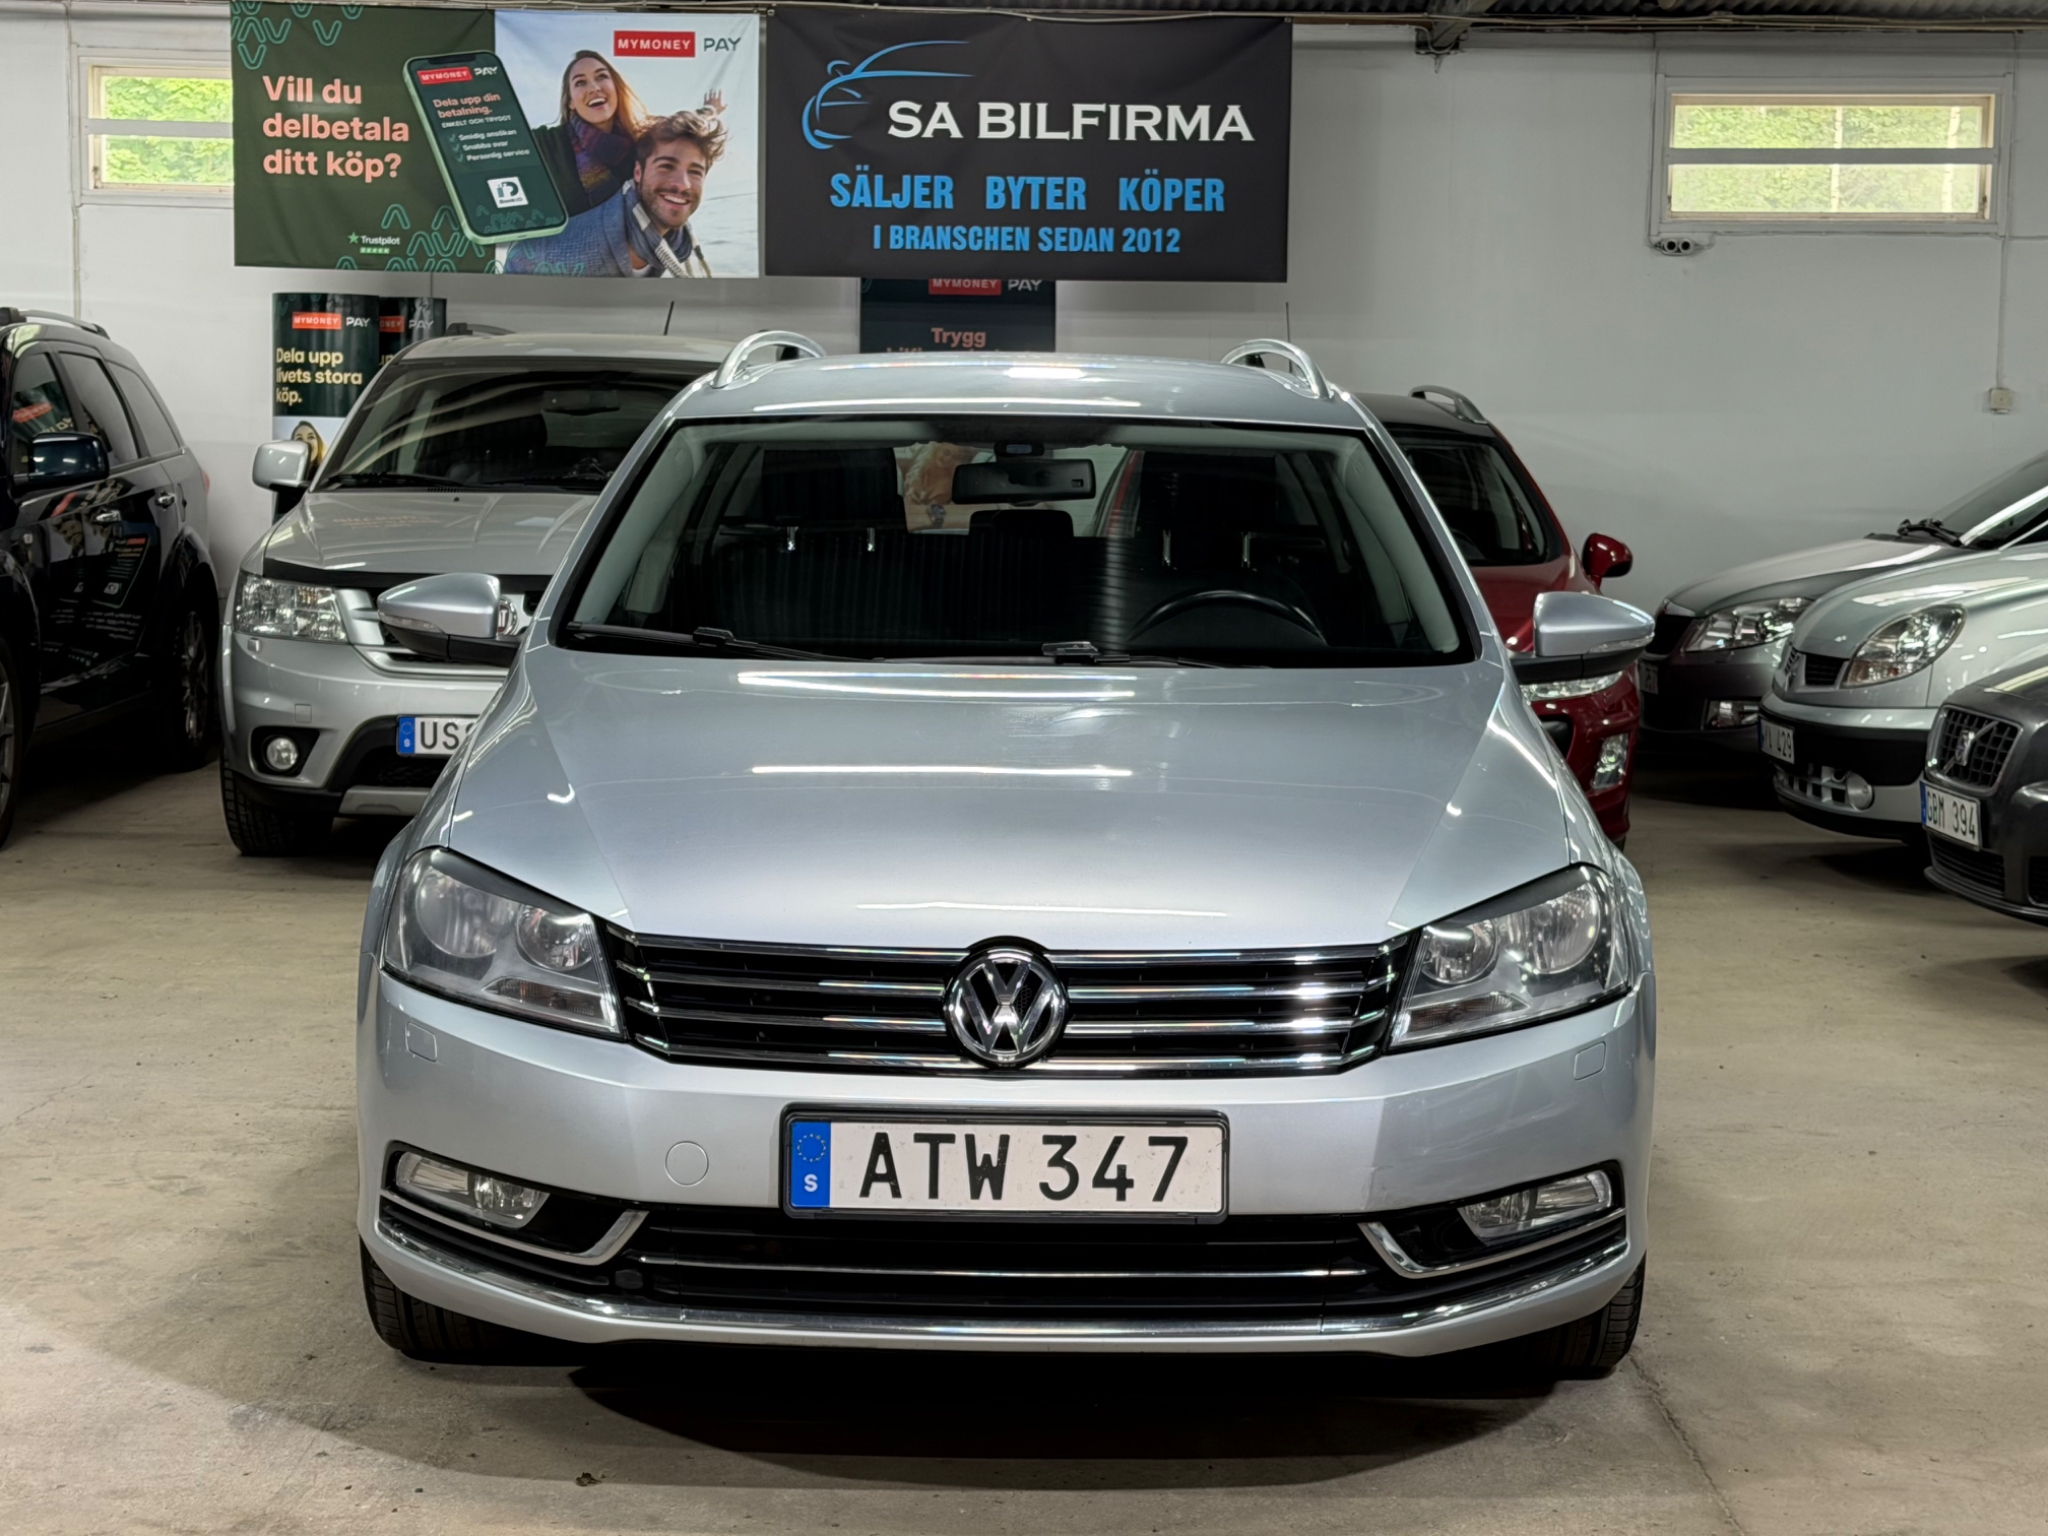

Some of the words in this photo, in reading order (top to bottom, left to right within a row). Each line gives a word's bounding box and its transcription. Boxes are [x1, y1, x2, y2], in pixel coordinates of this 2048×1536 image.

[617, 38, 691, 51] MYMONEY
[703, 37, 742, 52] PAY
[420, 70, 468, 81] MYMONEY
[473, 66, 498, 76] PAY
[262, 75, 313, 103] Vill
[321, 78, 362, 105] du
[432, 98, 459, 108] Dela
[460, 96, 482, 106] upp
[482, 93, 501, 103] din
[436, 106, 493, 119] betalning.
[887, 101, 964, 139] SA
[977, 103, 1256, 142] BILFIRMA
[262, 112, 410, 142] delbetala
[262, 148, 319, 176] ditt
[326, 150, 402, 184] köp?
[830, 164, 954, 210] SÄLJER
[985, 176, 1087, 211] BYTER
[1118, 168, 1226, 213] KÖPER
[360, 235, 401, 247] Trustpilot
[873, 225, 882, 250] I
[889, 225, 1031, 252] BRANSCHEN
[1037, 227, 1115, 253] SEDAN
[1121, 228, 1182, 254] 2012
[932, 278, 999, 290] MYMONEY
[1007, 279, 1043, 292] PAY
[293, 315, 340, 326] MYMONEY
[345, 316, 371, 328] PAY
[408, 319, 435, 330] PAY
[931, 327, 987, 348] Trygg
[276, 347, 305, 364] Dela
[308, 350, 344, 368] upp
[276, 367, 312, 384] livets
[314, 369, 363, 385] stora
[276, 387, 303, 406] köp.
[420, 721, 475, 751] US
[1952, 800, 1976, 840] 394
[858, 1132, 1011, 1201] ATW
[1038, 1134, 1189, 1203] 347
[803, 1173, 819, 1193] S
